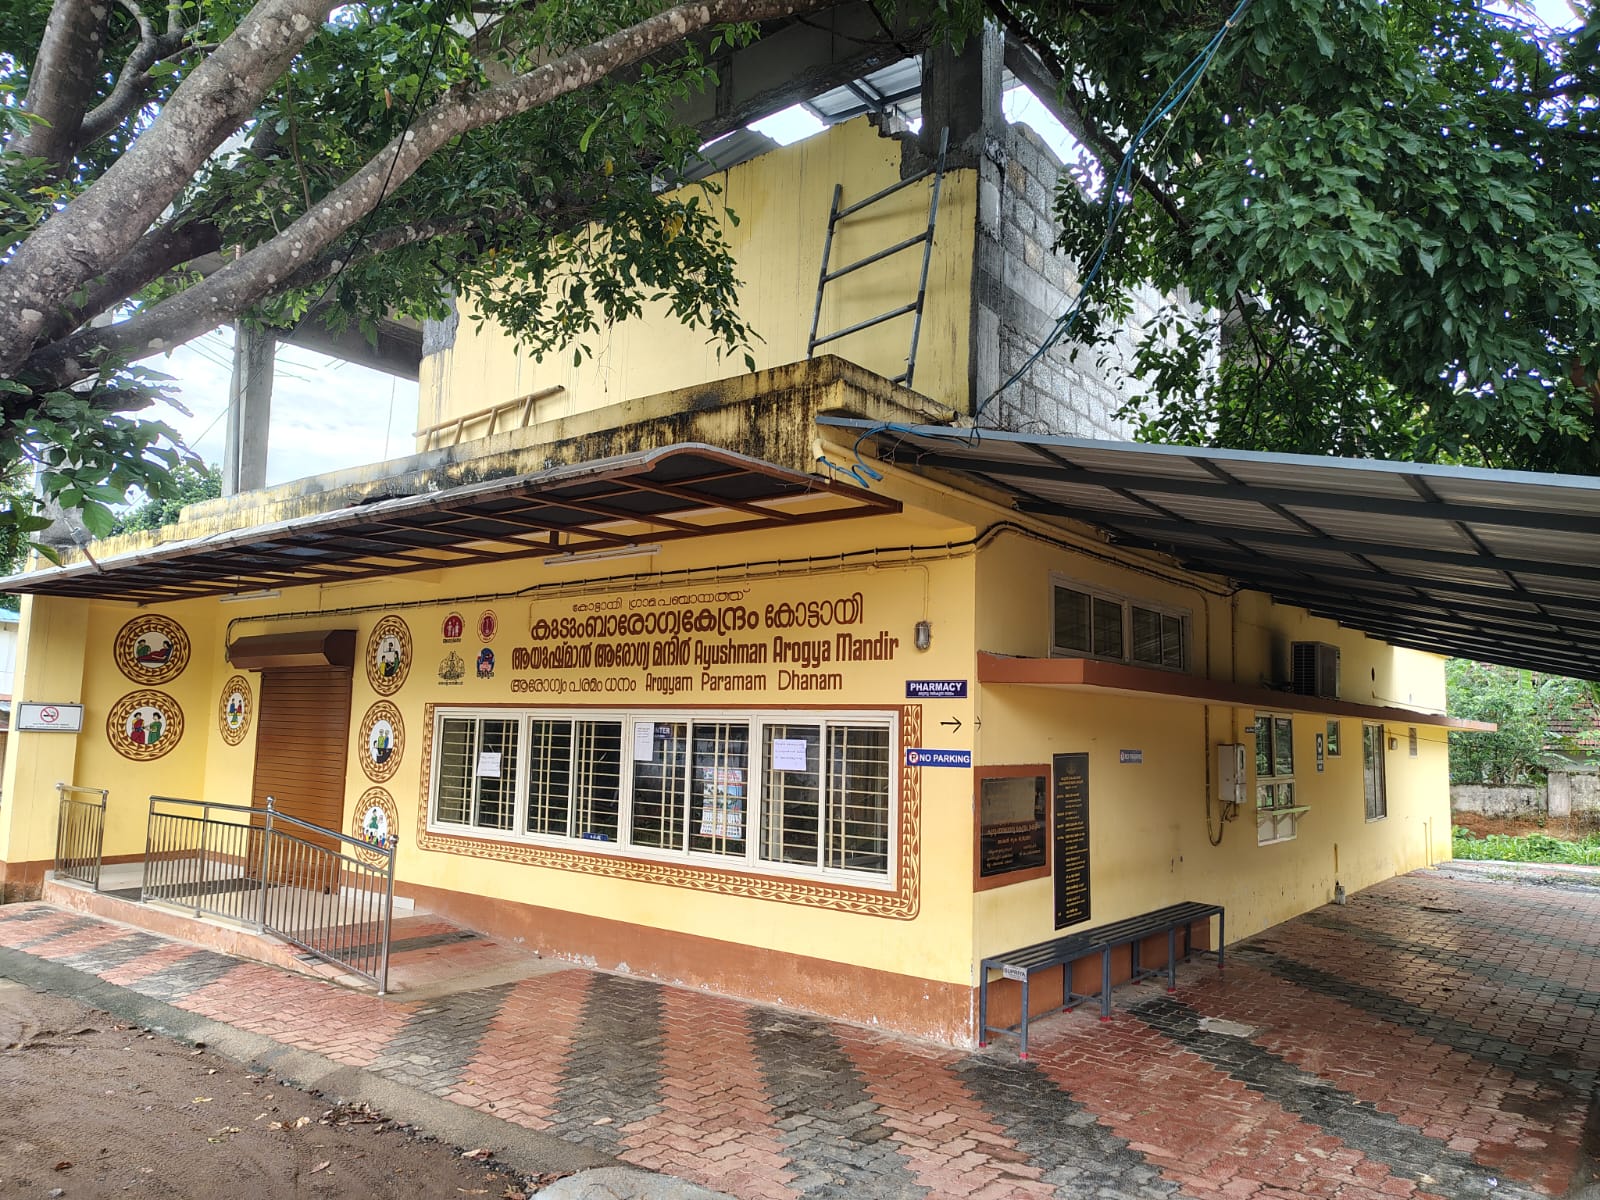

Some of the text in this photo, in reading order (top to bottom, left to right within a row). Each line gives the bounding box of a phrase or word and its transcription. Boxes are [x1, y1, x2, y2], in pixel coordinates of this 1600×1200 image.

[765, 592, 863, 628] കോട്ടായി
[594, 641, 650, 670] ആരോഗ്യ
[694, 638, 768, 670] Ayushman
[773, 636, 831, 668] Arogya
[836, 631, 899, 661] Mandir
[510, 670, 843, 695] ആരോഗ്യം പരമം ധനം Arogyam Paramam Dhanam
[910, 682, 962, 692] PHARMACY
[919, 754, 932, 762] NO
[933, 755, 970, 763] PARKING
